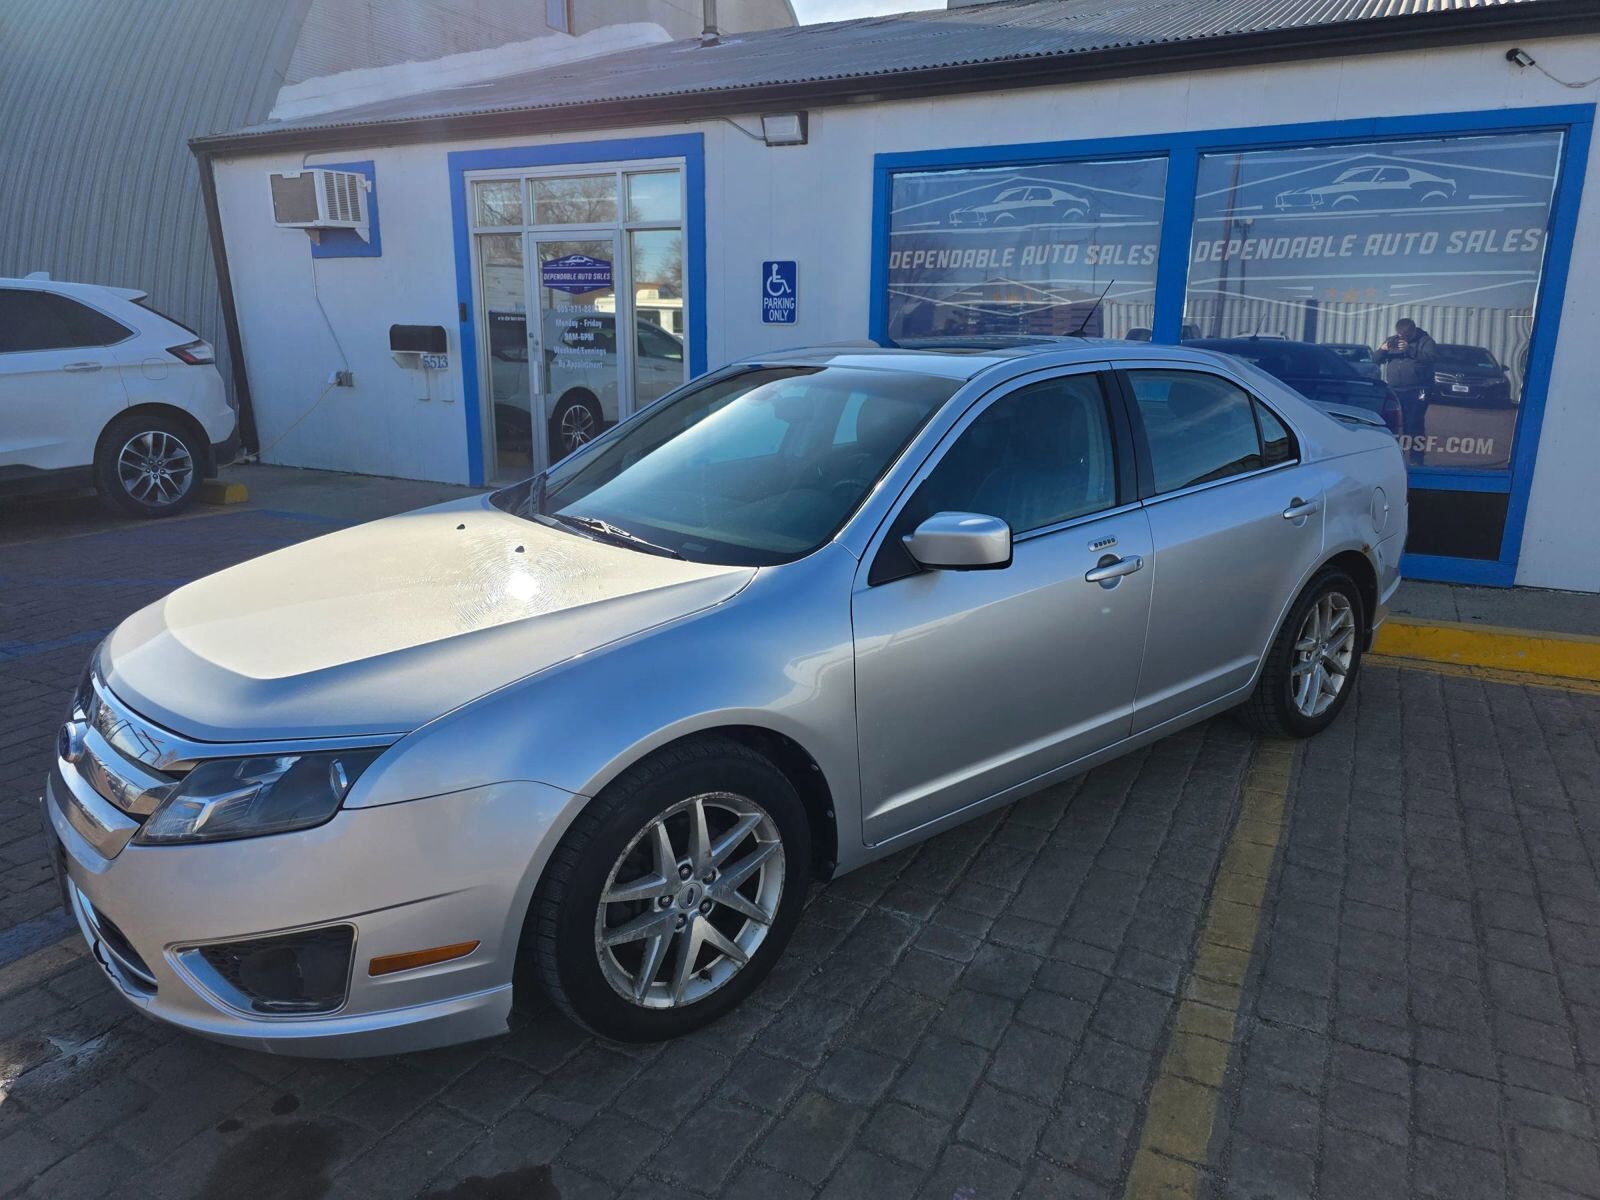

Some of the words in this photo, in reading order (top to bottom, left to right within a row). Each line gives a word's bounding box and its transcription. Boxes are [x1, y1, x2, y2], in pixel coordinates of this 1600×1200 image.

[1194, 235, 1358, 263] DEPENDABLE
[1362, 232, 1440, 257] AUTO
[1446, 228, 1542, 254] SALES
[889, 248, 1016, 269] DEPENDABLE
[1021, 245, 1078, 266] AUTO
[1084, 244, 1158, 265] SALES
[763, 297, 795, 309] PARKING
[769, 309, 789, 321] ONLY
[583, 319, 602, 329] Friday
[422, 355, 449, 369] 5513
